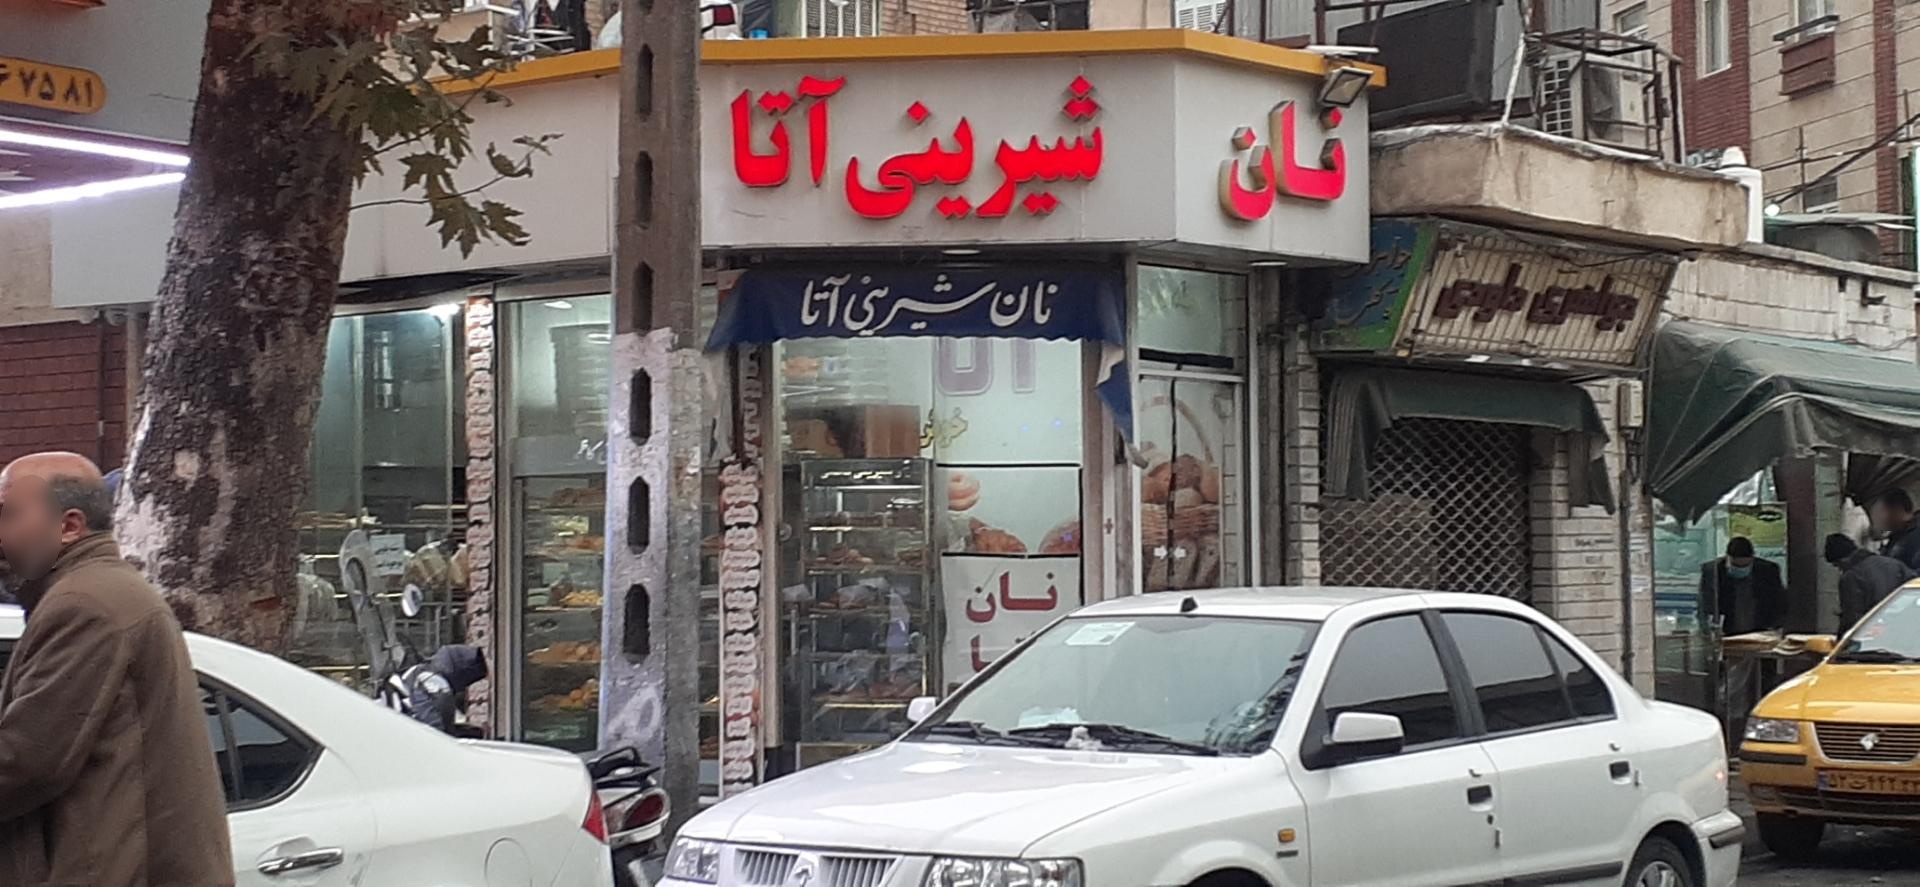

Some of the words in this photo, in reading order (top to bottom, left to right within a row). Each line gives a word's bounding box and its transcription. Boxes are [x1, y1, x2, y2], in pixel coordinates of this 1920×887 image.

[730, 75, 847, 187] آتا
[845, 75, 1104, 219] شیرینی
[1218, 100, 1346, 221] نان
[801, 274, 850, 327] آتا
[843, 274, 997, 336] شیرینی
[990, 281, 1058, 327] نان
[966, 570, 1058, 623] نان
